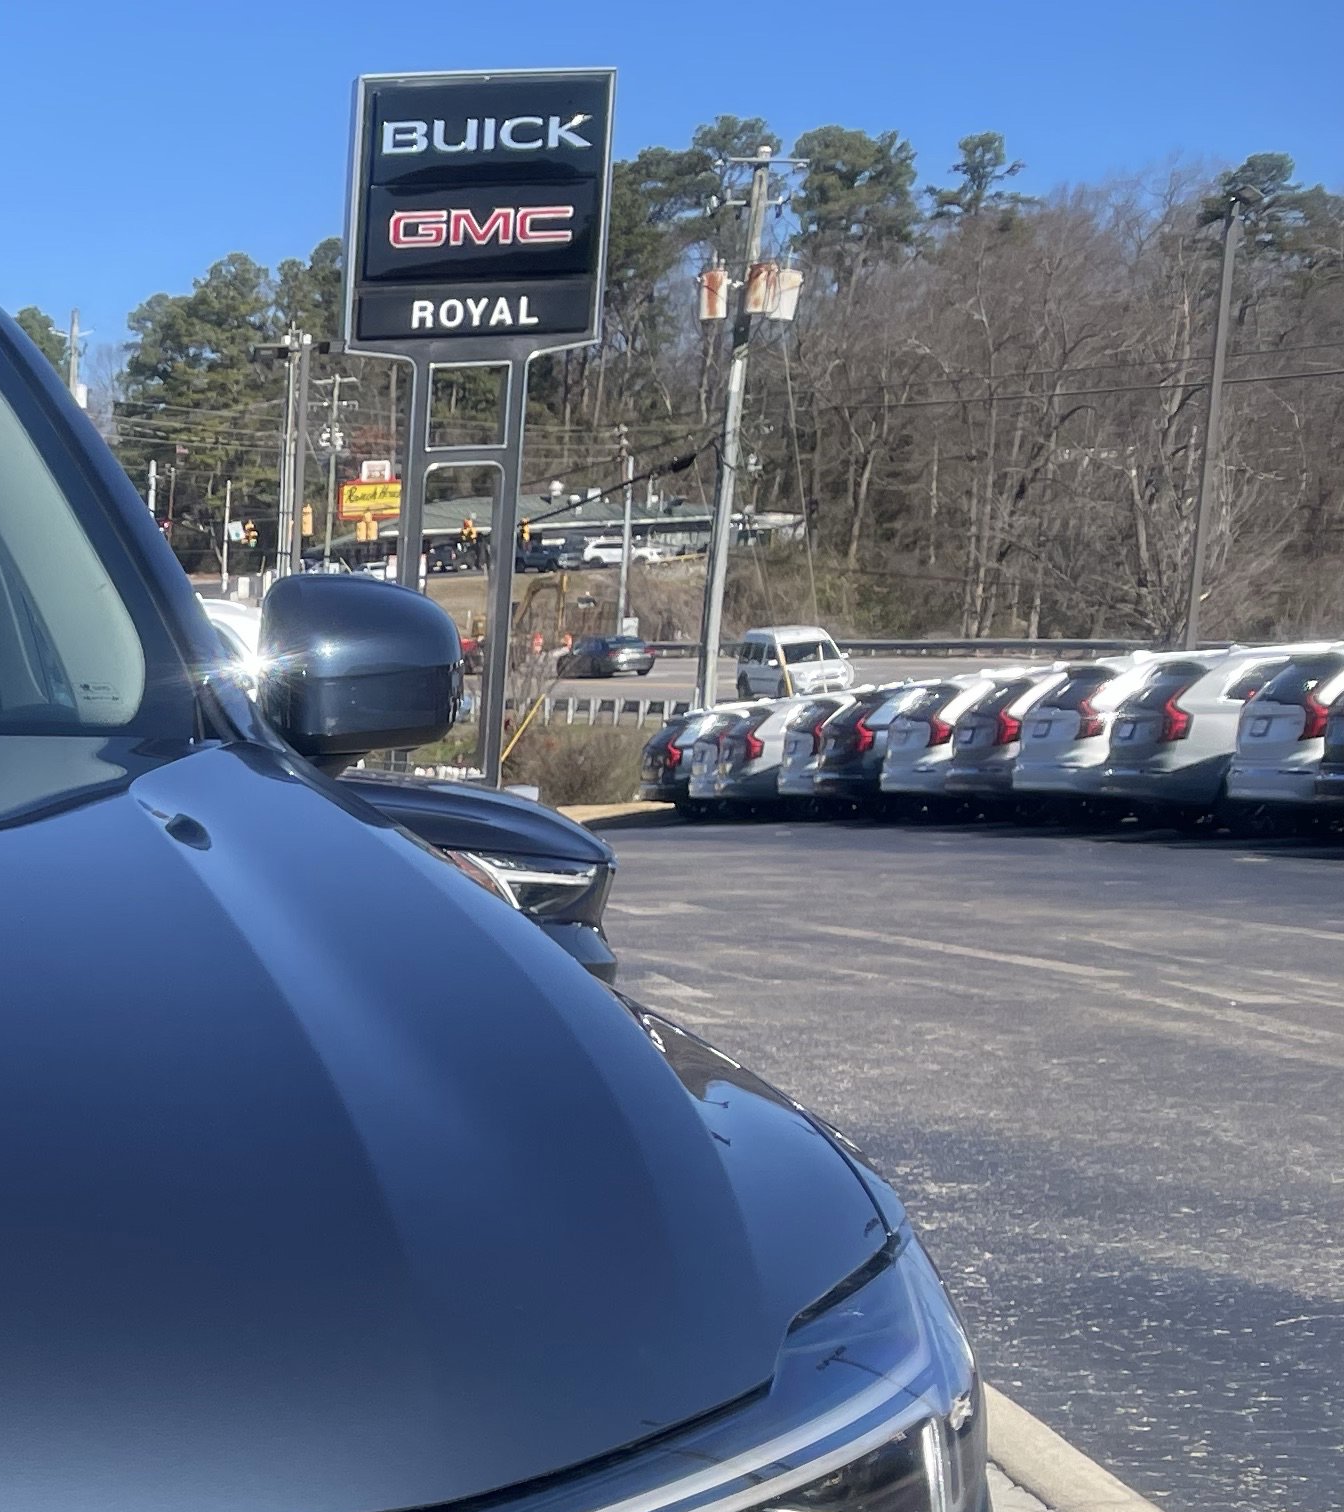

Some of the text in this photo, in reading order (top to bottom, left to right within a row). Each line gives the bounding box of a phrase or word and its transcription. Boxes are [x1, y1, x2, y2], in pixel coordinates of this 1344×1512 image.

[381, 115, 593, 155] BUICK
[389, 206, 574, 249] GMC
[411, 296, 539, 329] ROYAL
